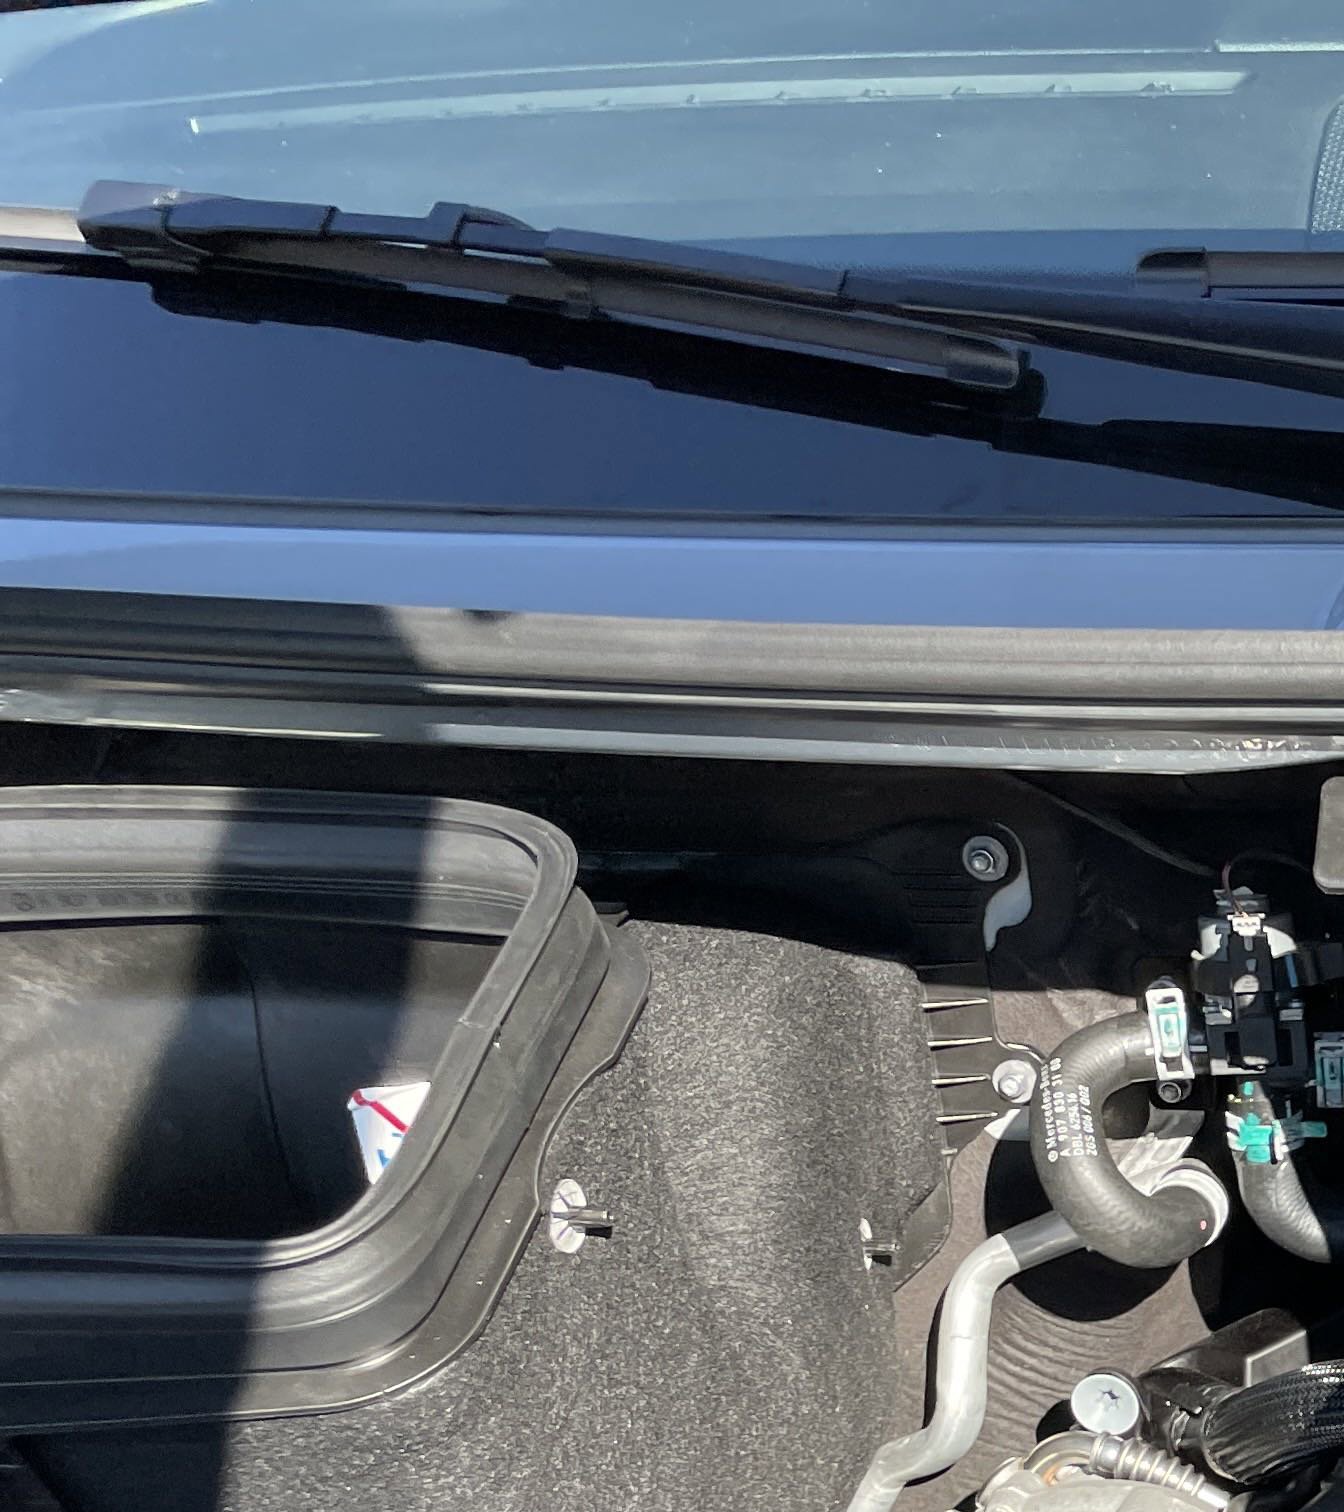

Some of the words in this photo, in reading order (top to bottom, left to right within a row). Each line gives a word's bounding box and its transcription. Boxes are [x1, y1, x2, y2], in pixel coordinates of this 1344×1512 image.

[1040, 1064, 1057, 1149] Mercedes-Benz
[1056, 1120, 1068, 1141] 907
[1060, 1148, 1072, 1157] A
[1072, 1133, 1085, 1156] DBL
[1085, 1135, 1098, 1156] ZGS
